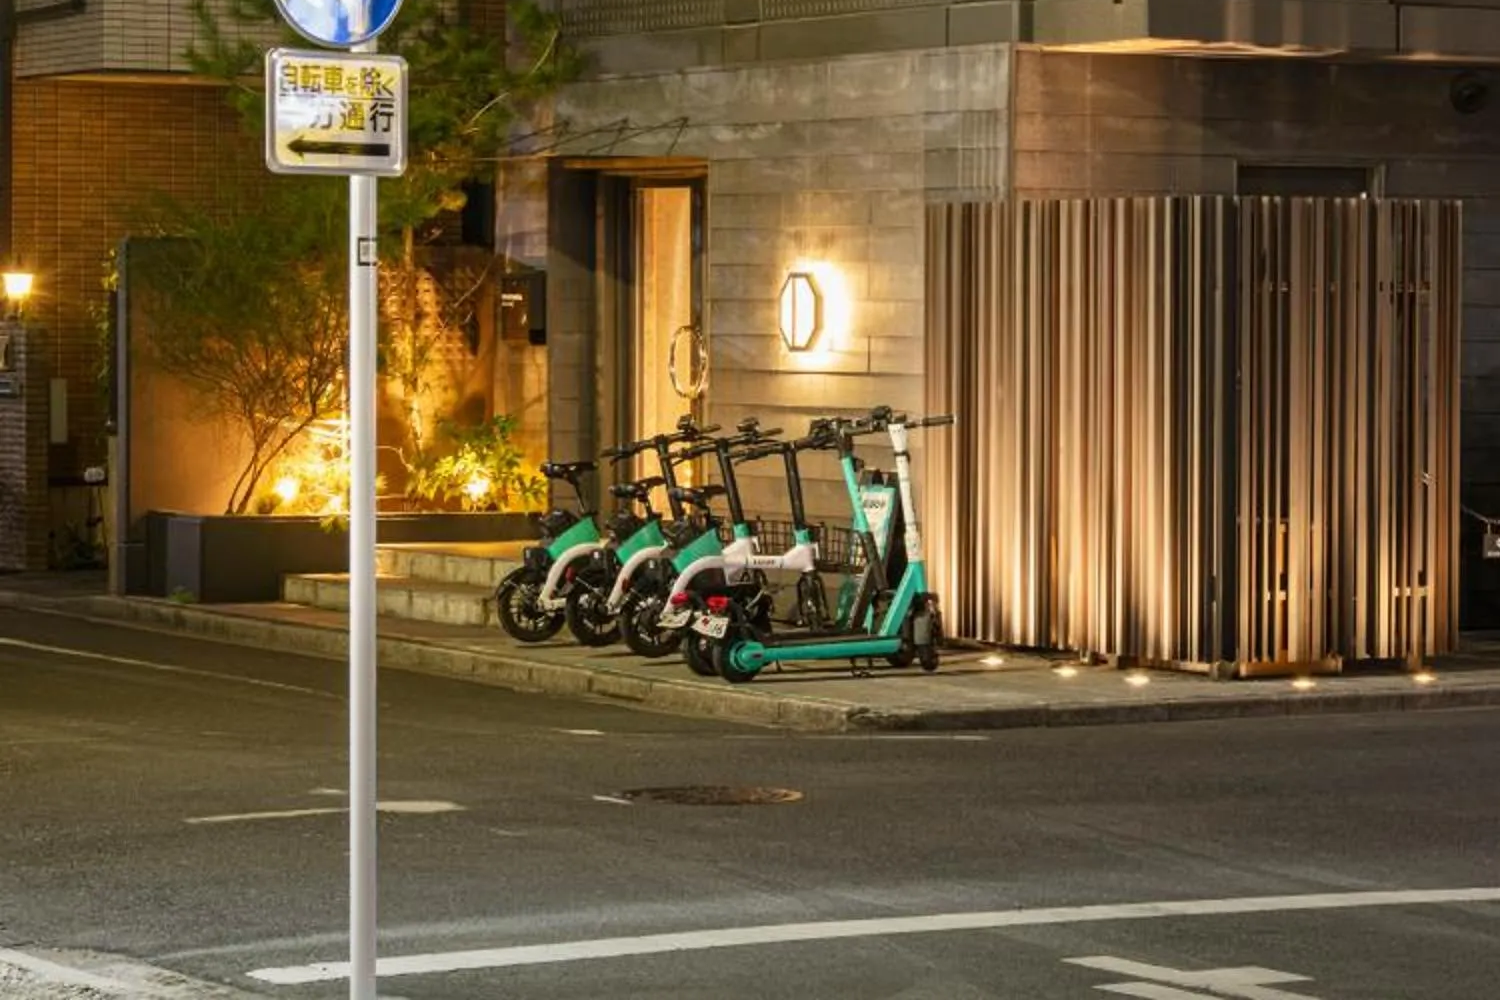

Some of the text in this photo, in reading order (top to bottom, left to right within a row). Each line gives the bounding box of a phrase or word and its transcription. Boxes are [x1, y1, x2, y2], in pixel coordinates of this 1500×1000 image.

[280, 63, 395, 99] 自転車を除く
